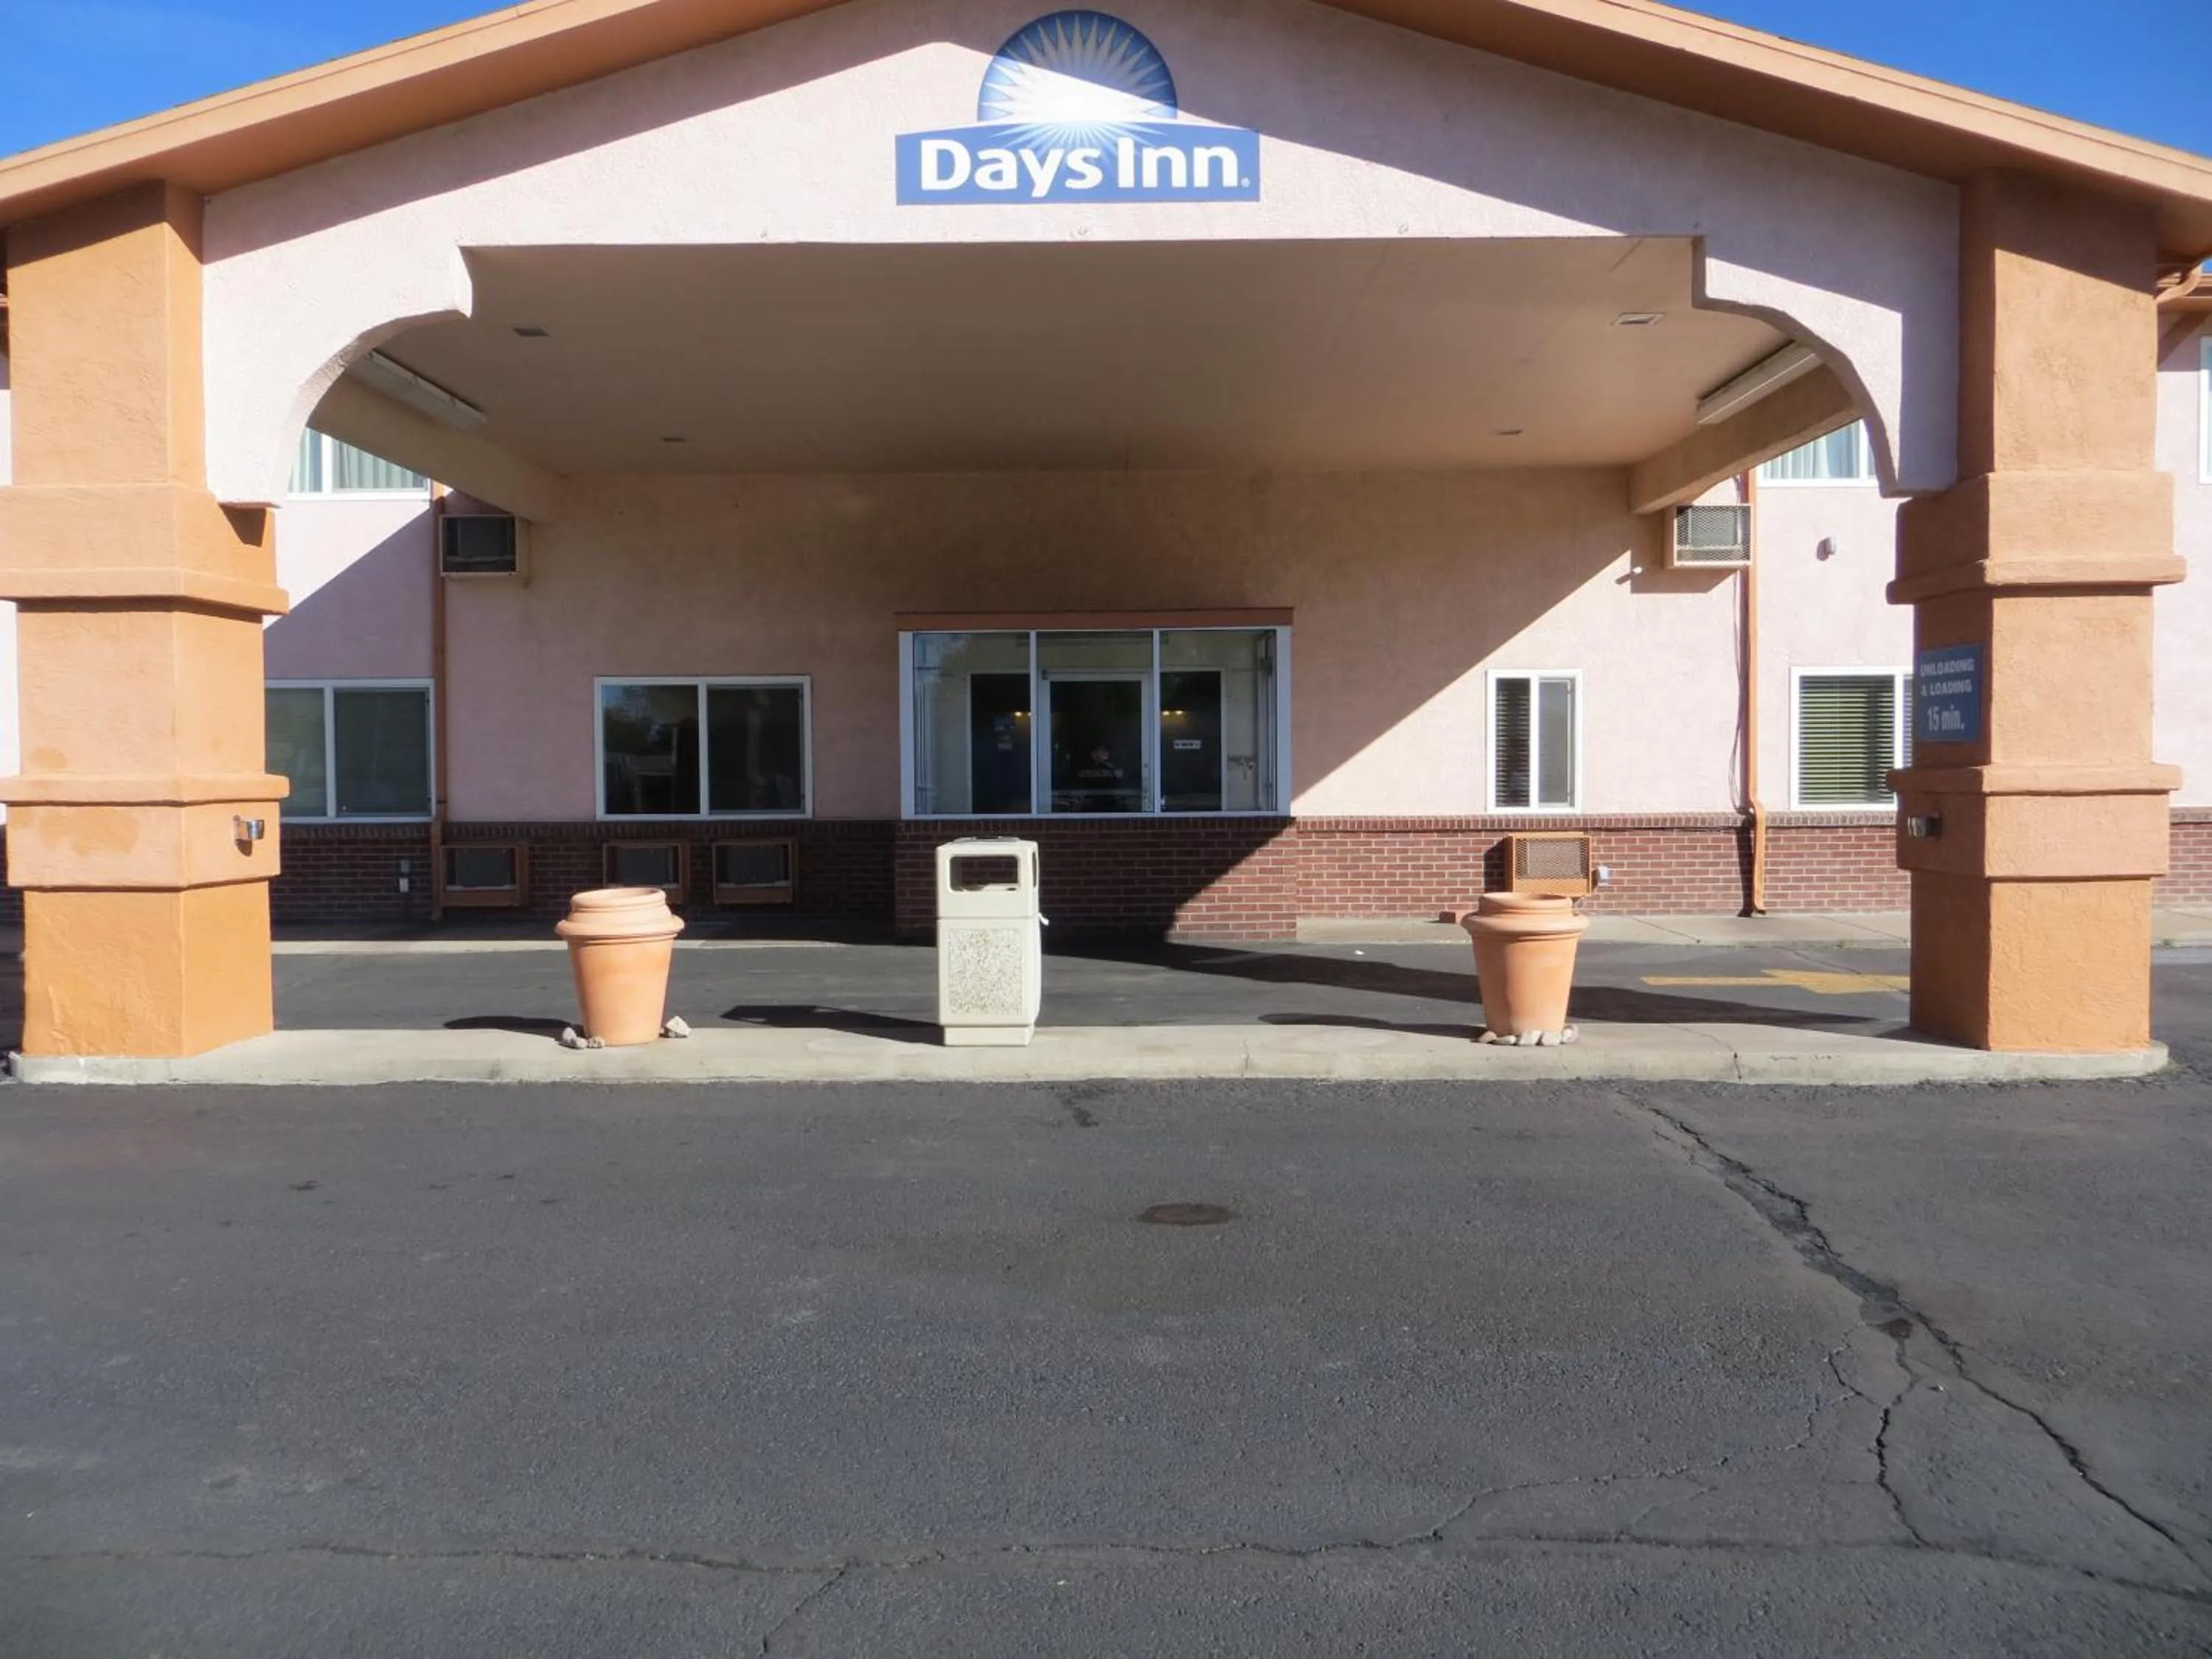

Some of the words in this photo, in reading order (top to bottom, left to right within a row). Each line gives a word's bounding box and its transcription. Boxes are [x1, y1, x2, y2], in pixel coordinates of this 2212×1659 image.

[920, 139, 1103, 198] Days
[1920, 658, 1975, 677] UNLOADING
[1930, 679, 1972, 696] LOADING
[1927, 706, 1939, 731] 15
[1941, 704, 1964, 731] min.
